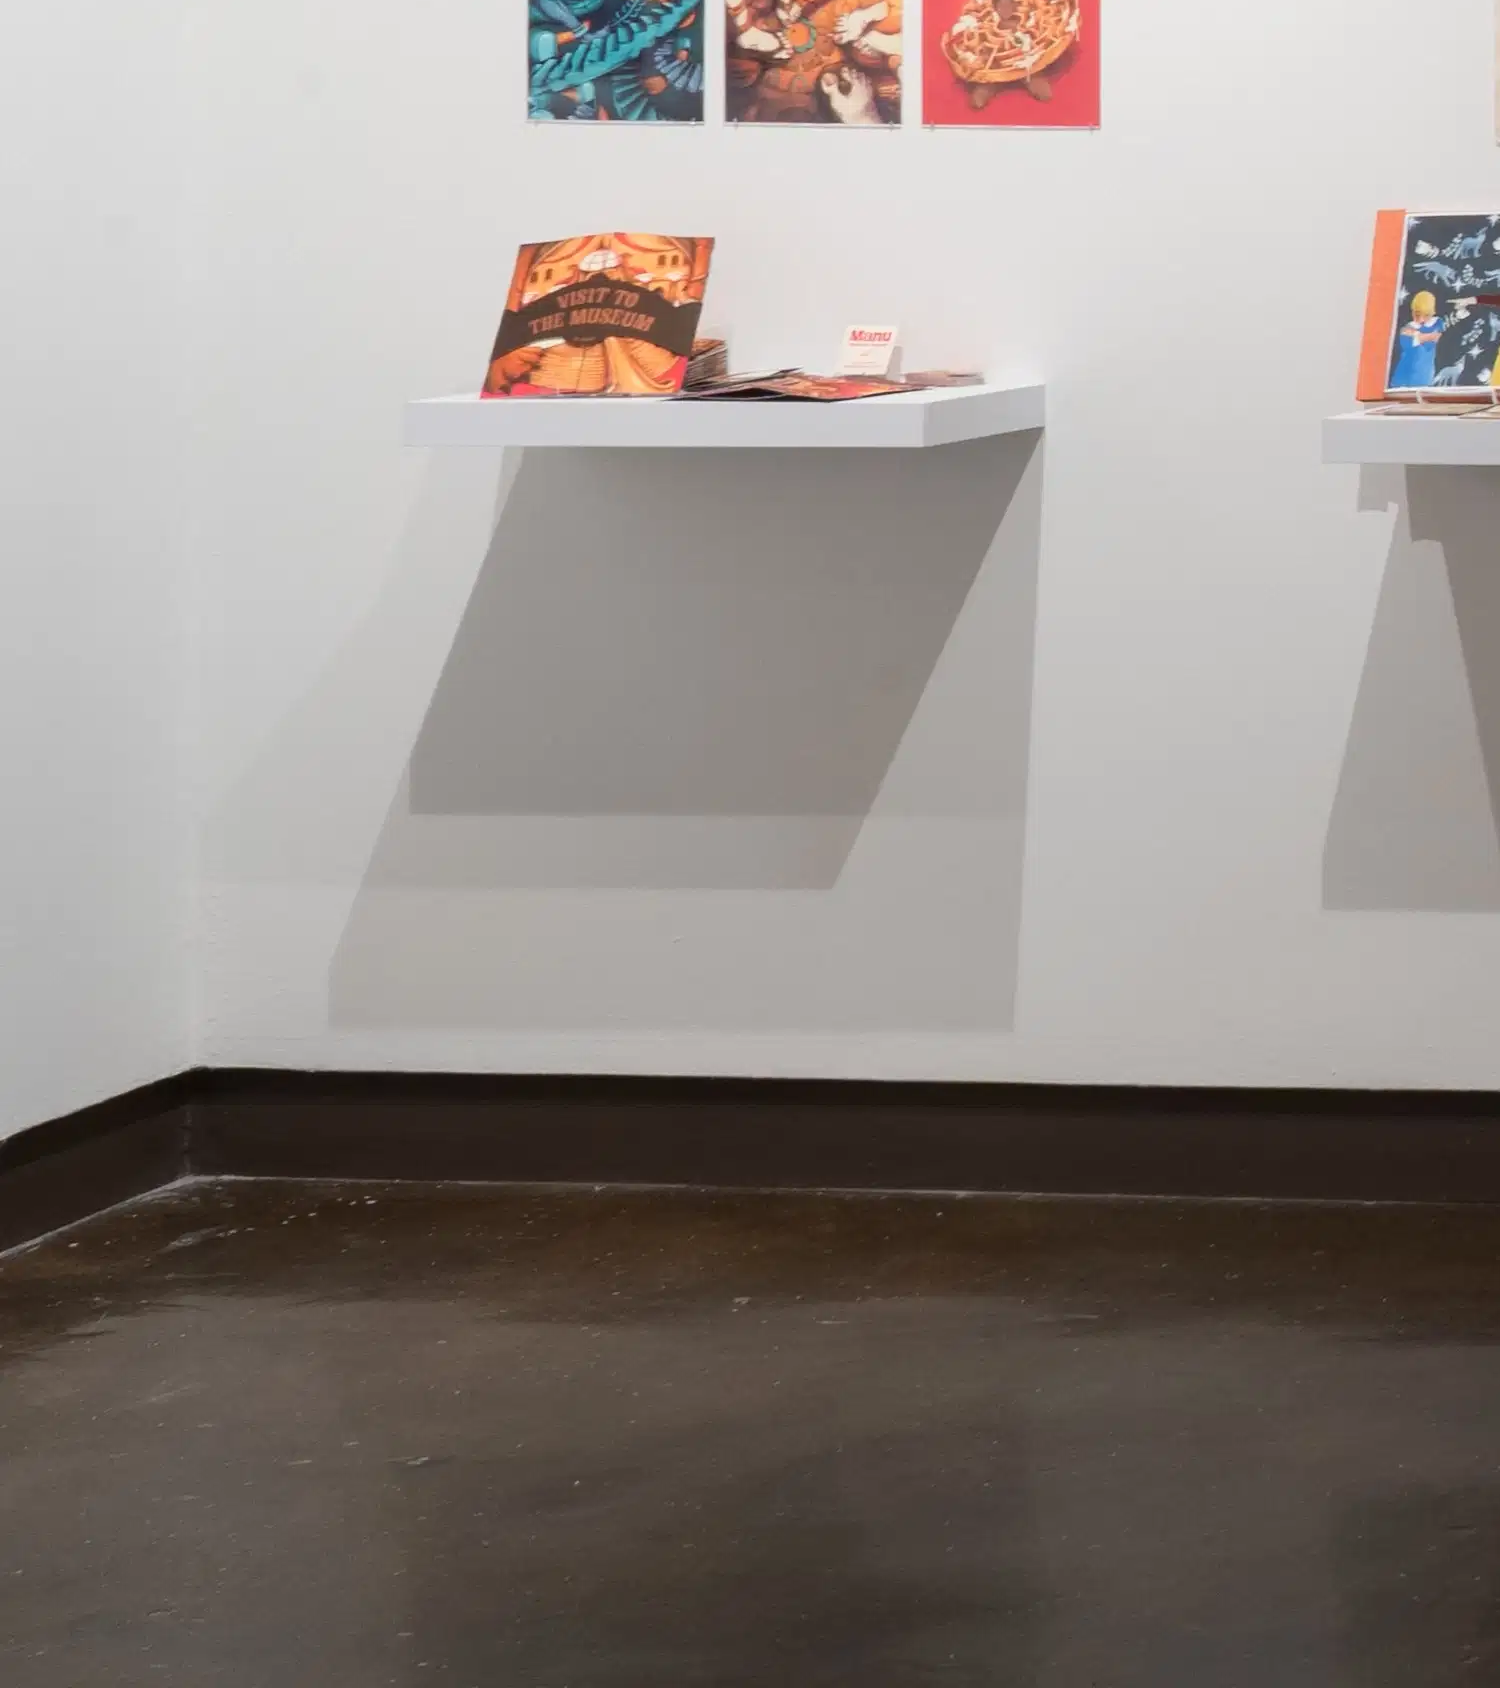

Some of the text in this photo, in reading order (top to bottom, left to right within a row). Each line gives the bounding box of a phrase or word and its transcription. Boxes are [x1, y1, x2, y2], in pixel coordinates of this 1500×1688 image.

[556, 287, 640, 309] VISIT TO
[528, 308, 656, 335] THE MUSEUM
